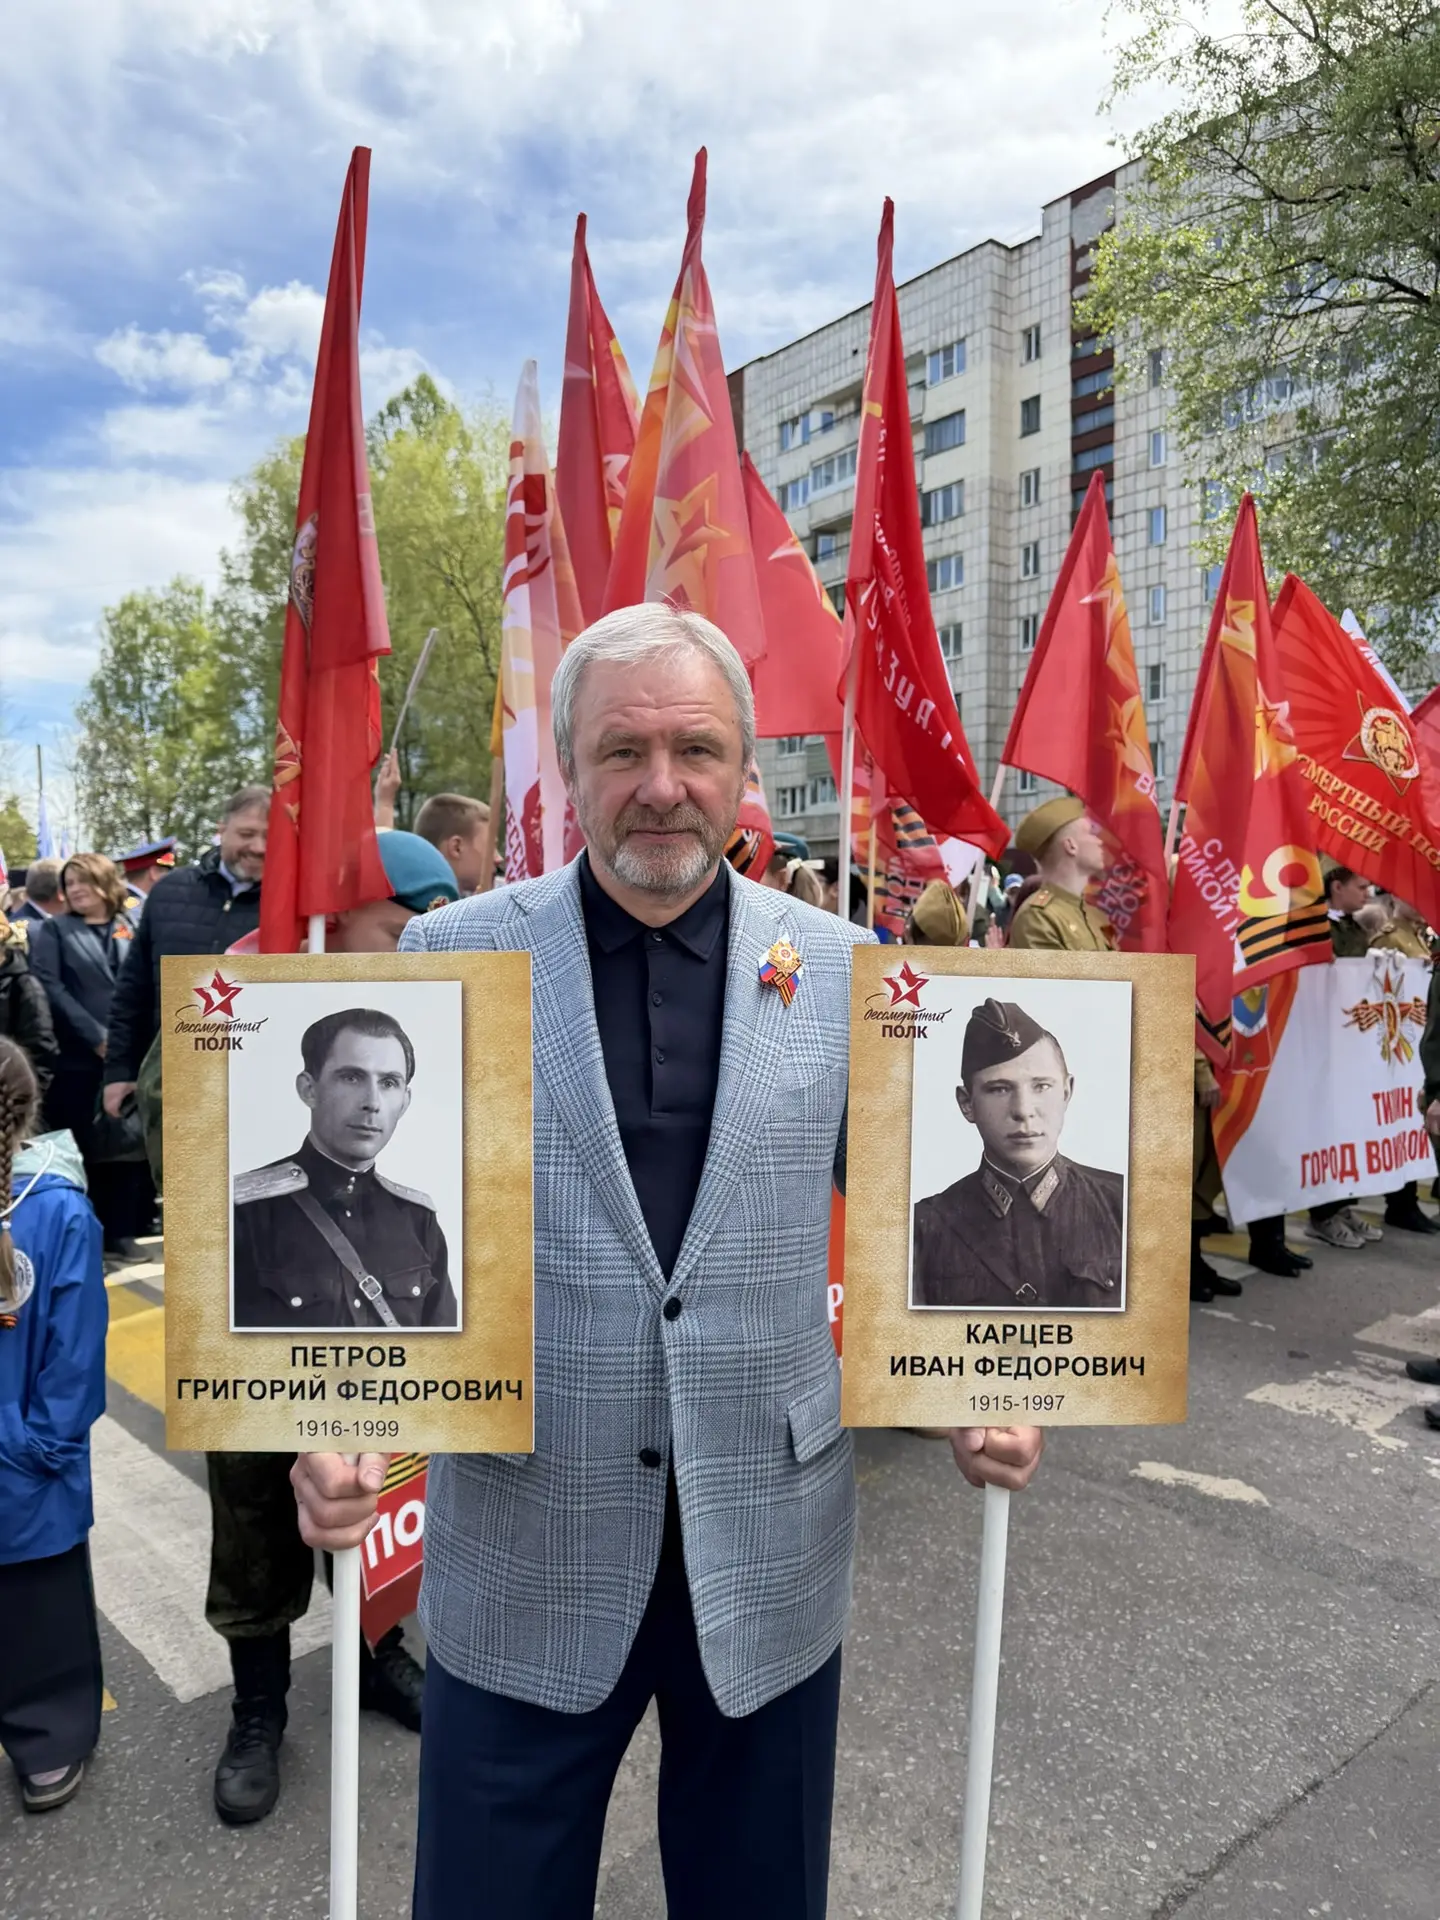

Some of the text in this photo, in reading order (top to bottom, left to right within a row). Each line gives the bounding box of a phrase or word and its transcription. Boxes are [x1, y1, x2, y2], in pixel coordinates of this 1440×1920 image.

[1297, 754, 1440, 871] СМЕРТНЫЙ ПО
[1307, 794, 1389, 852] РОССИИ
[174, 1004, 269, 1036] бессмертный
[864, 992, 953, 1024] бессмертный
[194, 1036, 243, 1051] ПОЛК
[881, 1024, 928, 1039] ПОЛК
[1300, 1143, 1360, 1189] ГОРОД
[966, 1323, 1074, 1348] КАРЦЕВ
[291, 1345, 407, 1368] ПЕТРОВ
[890, 1355, 1146, 1381] ИВАН ФЕДОРОВИЧ
[177, 1374, 524, 1405] ГРИГОРИЙ ФЕДОРОВИЧ
[968, 1394, 1066, 1412] 1915-1997
[296, 1419, 400, 1438] 1916-1999
[365, 1499, 426, 1570] ПО
